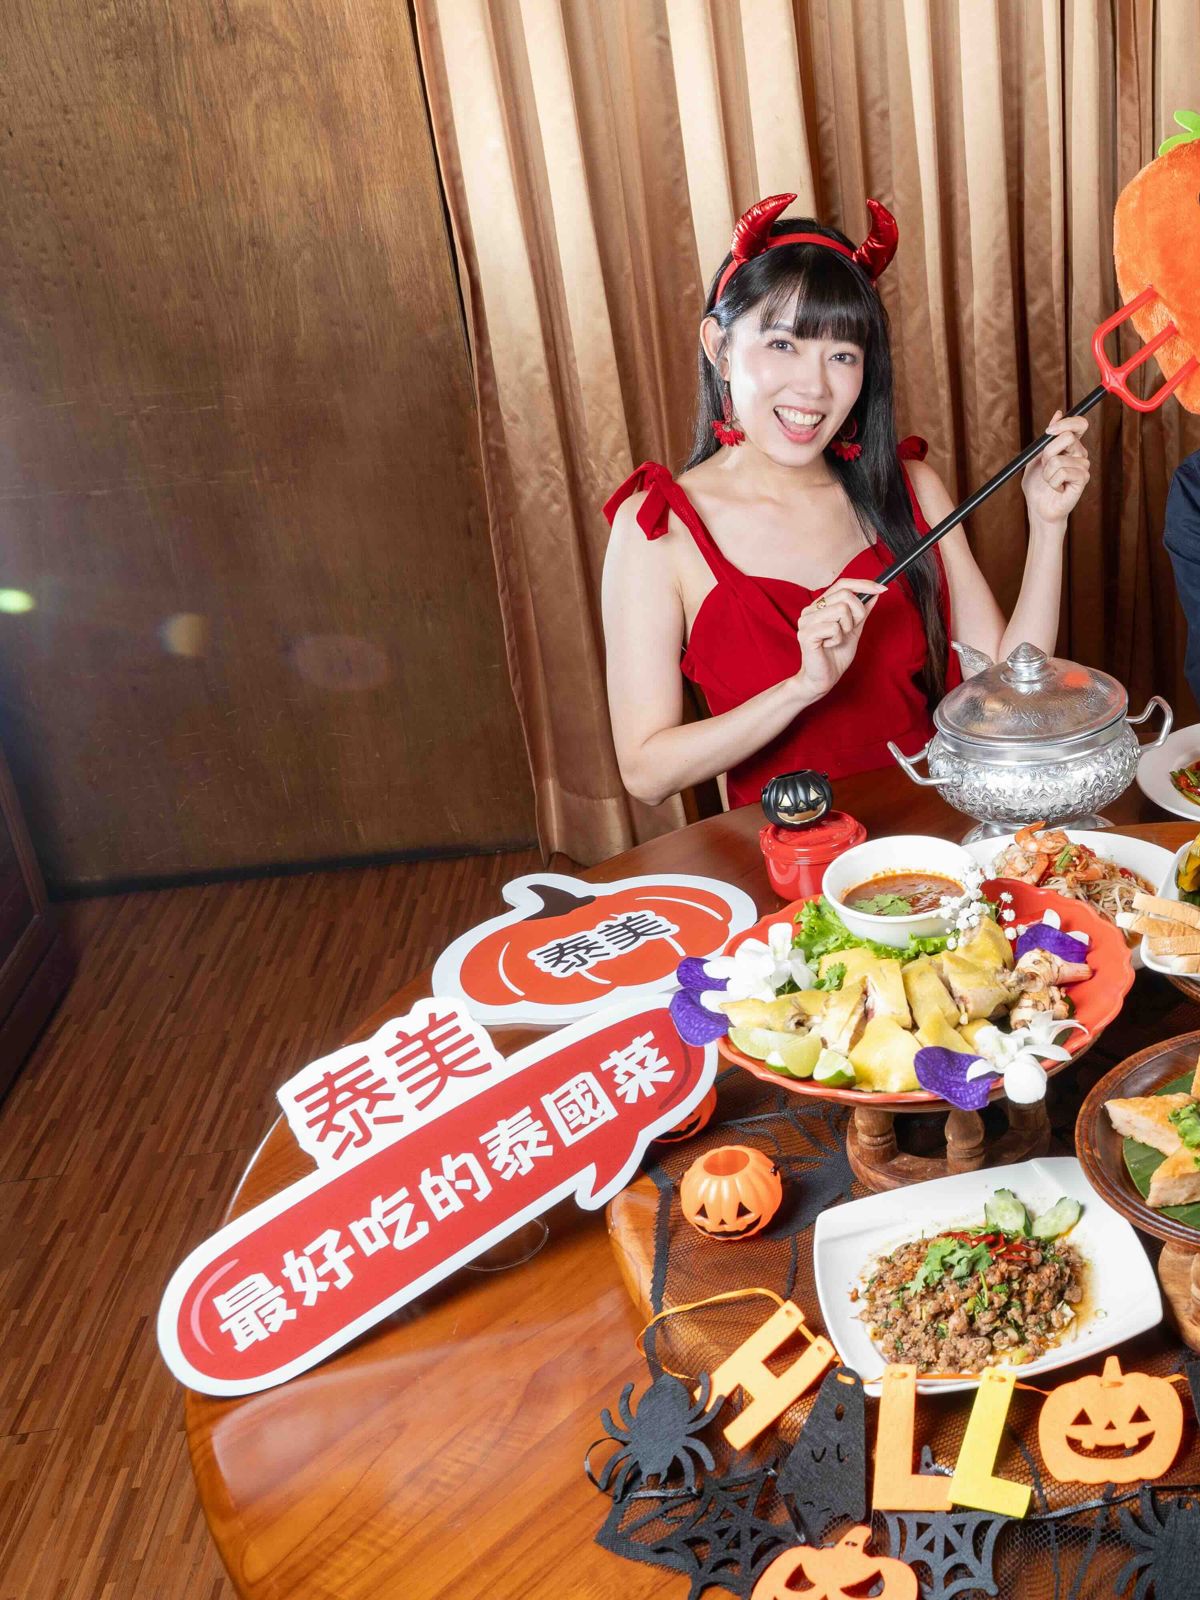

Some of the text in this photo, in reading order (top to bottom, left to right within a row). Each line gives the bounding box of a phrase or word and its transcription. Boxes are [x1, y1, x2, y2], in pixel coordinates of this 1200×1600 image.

[535, 911, 671, 974] 泰美
[293, 1010, 493, 1161] 泰美
[211, 1030, 676, 1354] 最好吃的泰國菜
